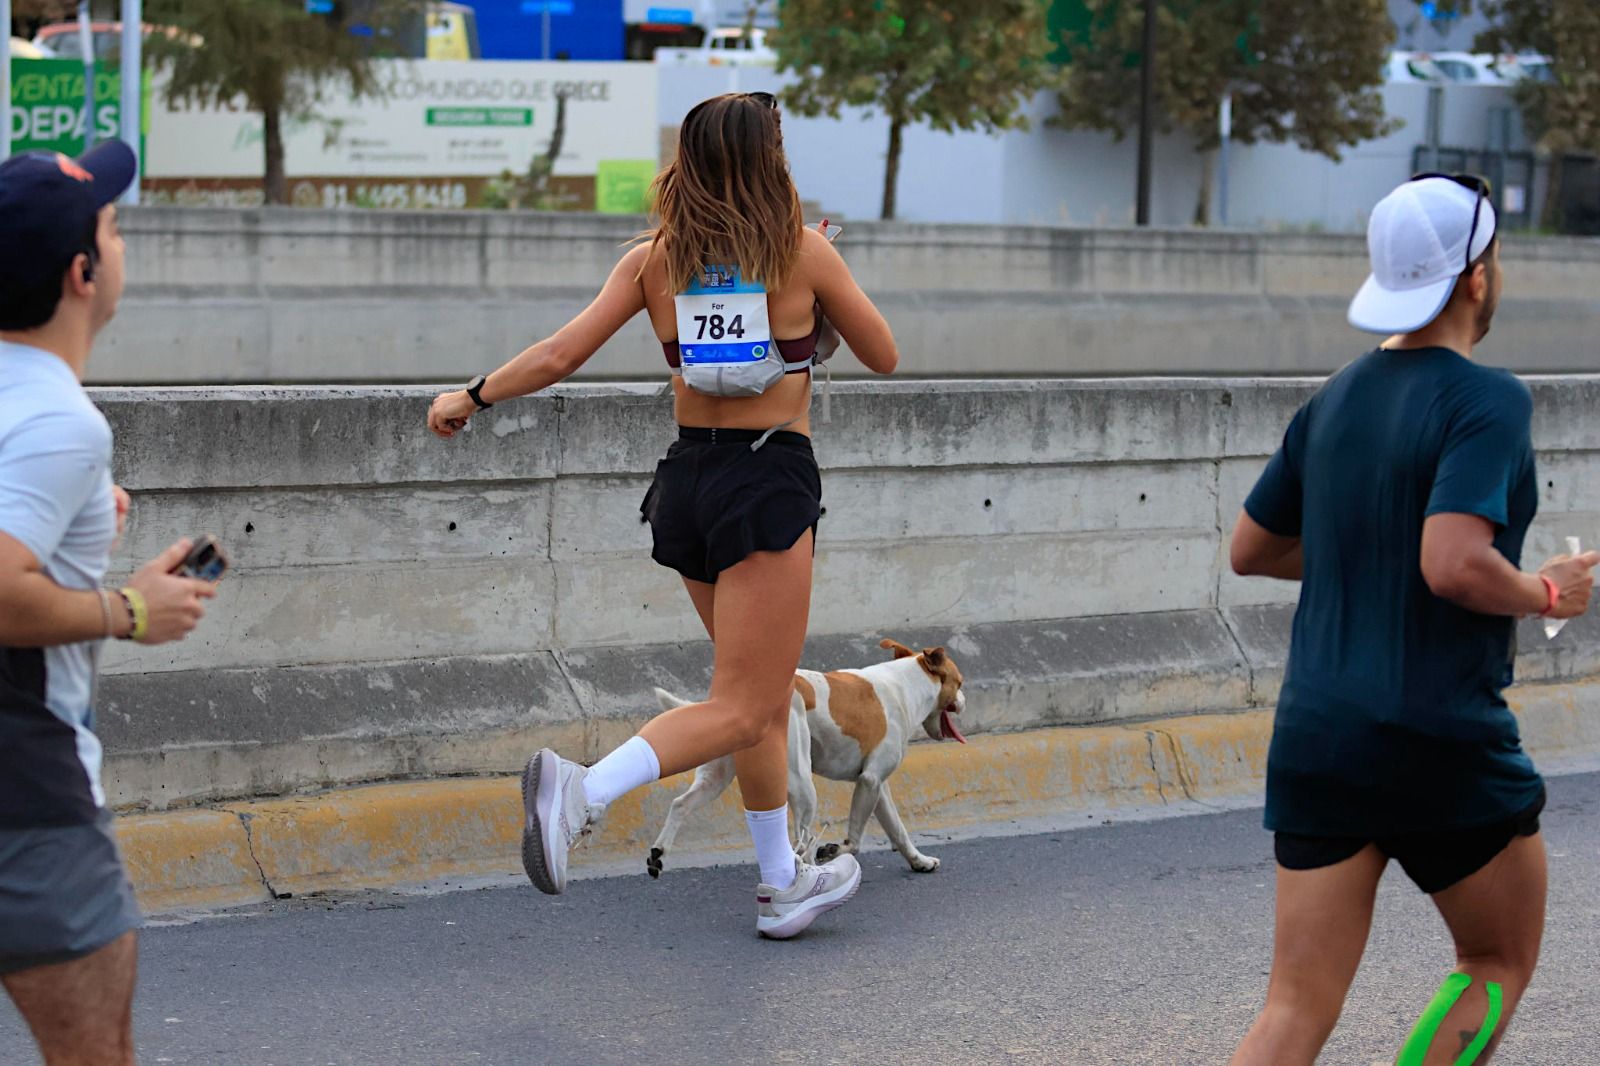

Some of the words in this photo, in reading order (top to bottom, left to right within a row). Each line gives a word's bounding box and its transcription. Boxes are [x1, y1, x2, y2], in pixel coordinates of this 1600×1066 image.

[11, 74, 85, 101] VENTA
[510, 79, 547, 101] QUE
[11, 104, 118, 140] DEPAS
[693, 314, 745, 340] 784
